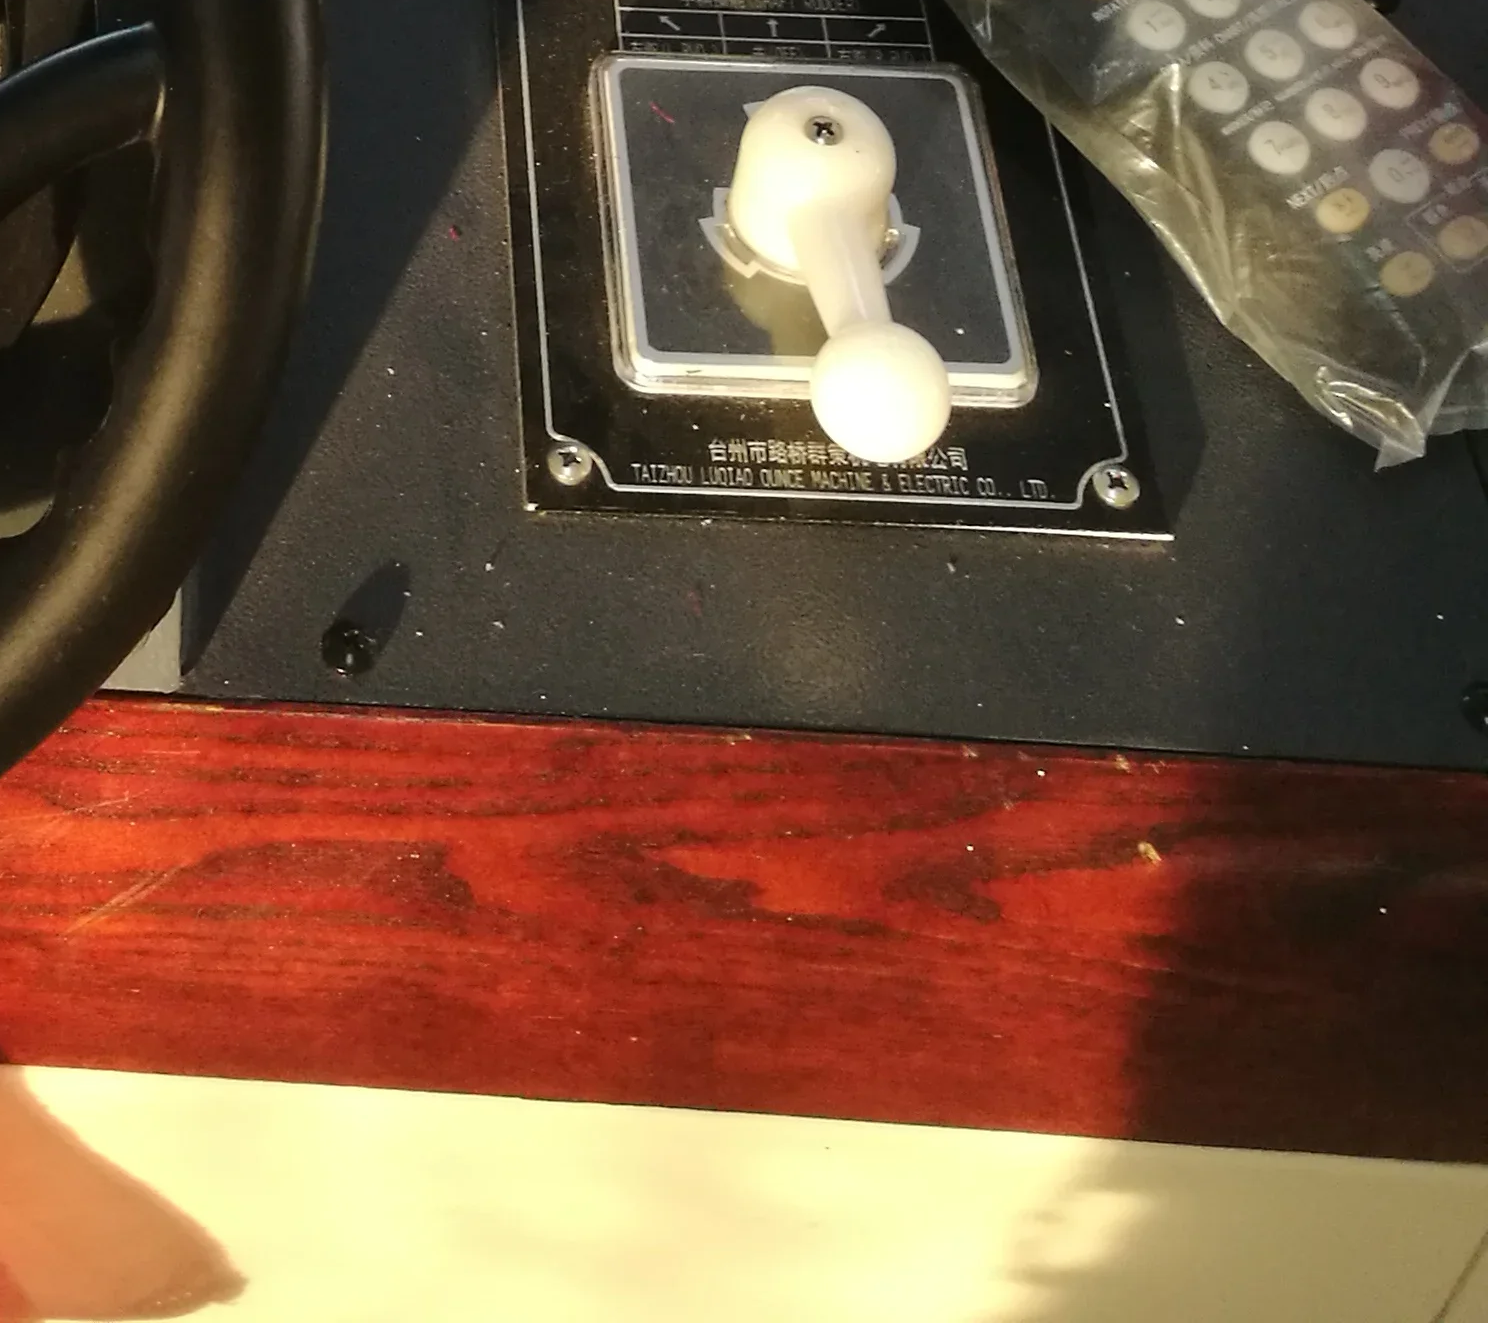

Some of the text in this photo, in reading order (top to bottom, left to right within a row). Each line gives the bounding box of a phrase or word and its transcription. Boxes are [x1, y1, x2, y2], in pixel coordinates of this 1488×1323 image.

[708, 438, 968, 471] 台州市路桥群策公司
[630, 462, 693, 484] TAIZHOU
[701, 465, 753, 487] LUQIAO
[761, 468, 806, 489] QUNCE
[811, 470, 874, 492] MACHINE
[898, 473, 971, 496] ELECTRIC
[1019, 478, 1057, 500] LTD.
